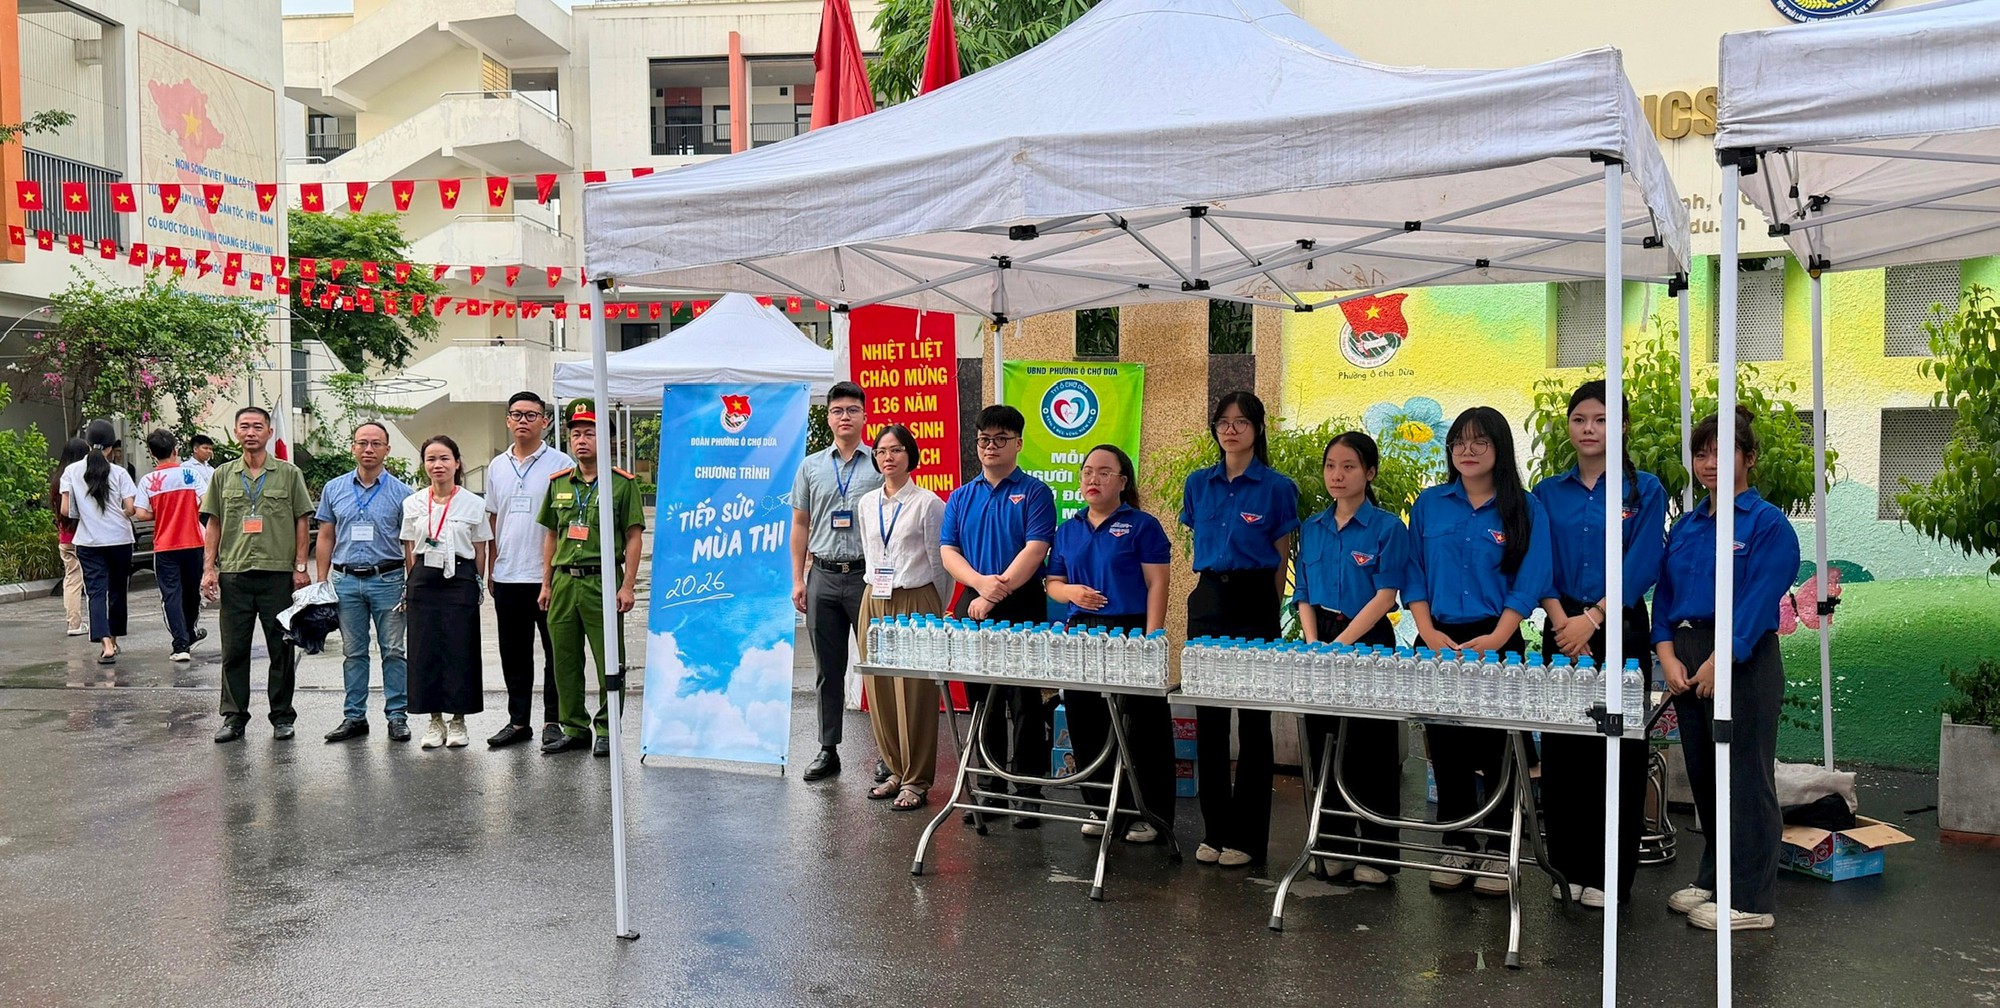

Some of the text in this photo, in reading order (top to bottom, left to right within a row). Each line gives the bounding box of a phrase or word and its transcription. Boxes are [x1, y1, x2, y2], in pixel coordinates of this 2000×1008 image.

[861, 336, 943, 363] NHIỆT LIỆT
[859, 363, 948, 388] CHÀO MỪNG
[1026, 365, 1118, 377] UBND PHƯỜNG Ô CHỢ DỪA
[1398, 368, 1415, 376] Dừa
[872, 391, 938, 414] 136 NĂM
[909, 420, 945, 440] SINH
[690, 435, 777, 449] ĐOÀN PHƯỜNG Ô CHỢ DỪA
[694, 464, 770, 480] CHƯƠNG TRÌNH
[915, 473, 954, 492] MINH
[679, 492, 755, 533] TIẾP SỨC
[691, 520, 786, 564] MÙA THI
[665, 571, 726, 600] 2026
